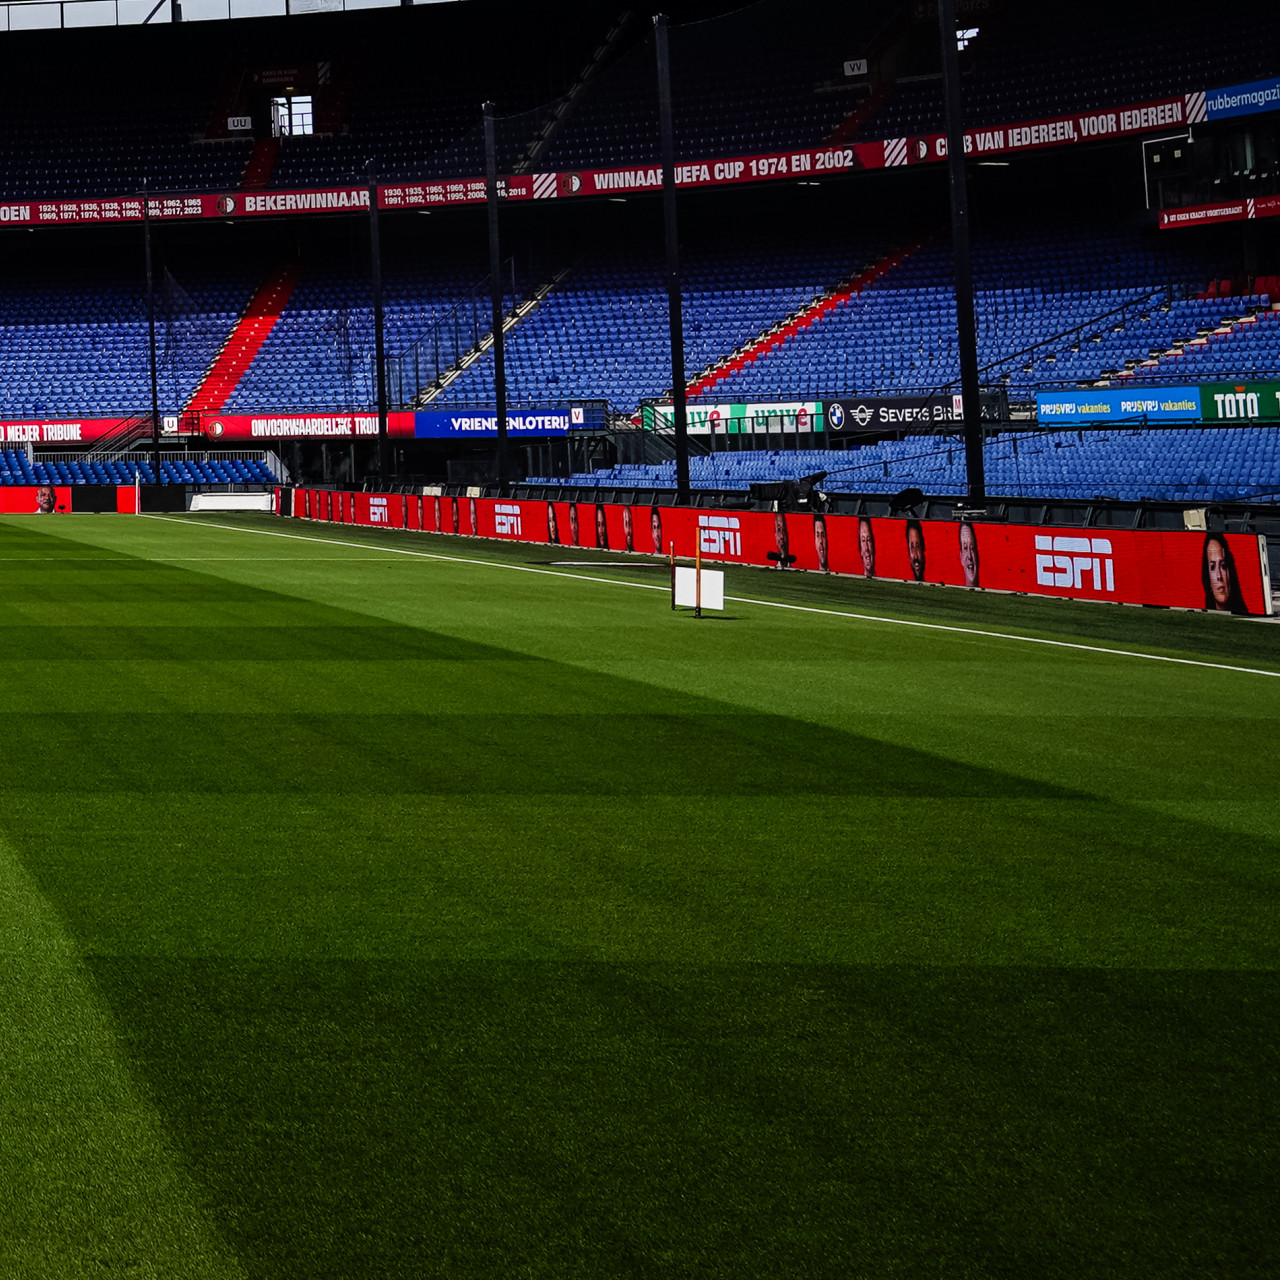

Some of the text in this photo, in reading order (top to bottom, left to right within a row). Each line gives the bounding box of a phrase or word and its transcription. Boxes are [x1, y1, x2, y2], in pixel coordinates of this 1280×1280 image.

[849, 62, 862, 73] VV
[233, 119, 246, 128] UU
[976, 130, 1004, 151] VAN
[1008, 120, 1078, 148] IEDEREEN,
[1079, 111, 1117, 136] VOOR
[1120, 102, 1182, 132] IEDEREEN
[674, 164, 710, 183] UEFA
[714, 160, 744, 179] CUP
[748, 156, 788, 176] 1974
[791, 152, 811, 170] EN
[814, 149, 854, 169] 2002
[245, 190, 370, 212] BEKERWINNAAR
[508, 187, 526, 196] 2018
[1077, 404, 1110, 414] vakanties
[1160, 400, 1196, 411] vakanties
[1214, 393, 1259, 418] TOTO
[167, 420, 174, 428] U
[574, 410, 581, 421] V
[7, 426, 40, 441] MEIJER
[42, 424, 81, 441] TRIBUNE
[251, 418, 352, 437] ONVOORWAARDELIJKE
[369, 497, 388, 522] ESPN
[495, 504, 522, 535] ESPN
[699, 515, 741, 556] ESPN
[1035, 535, 1115, 592] ESPN
